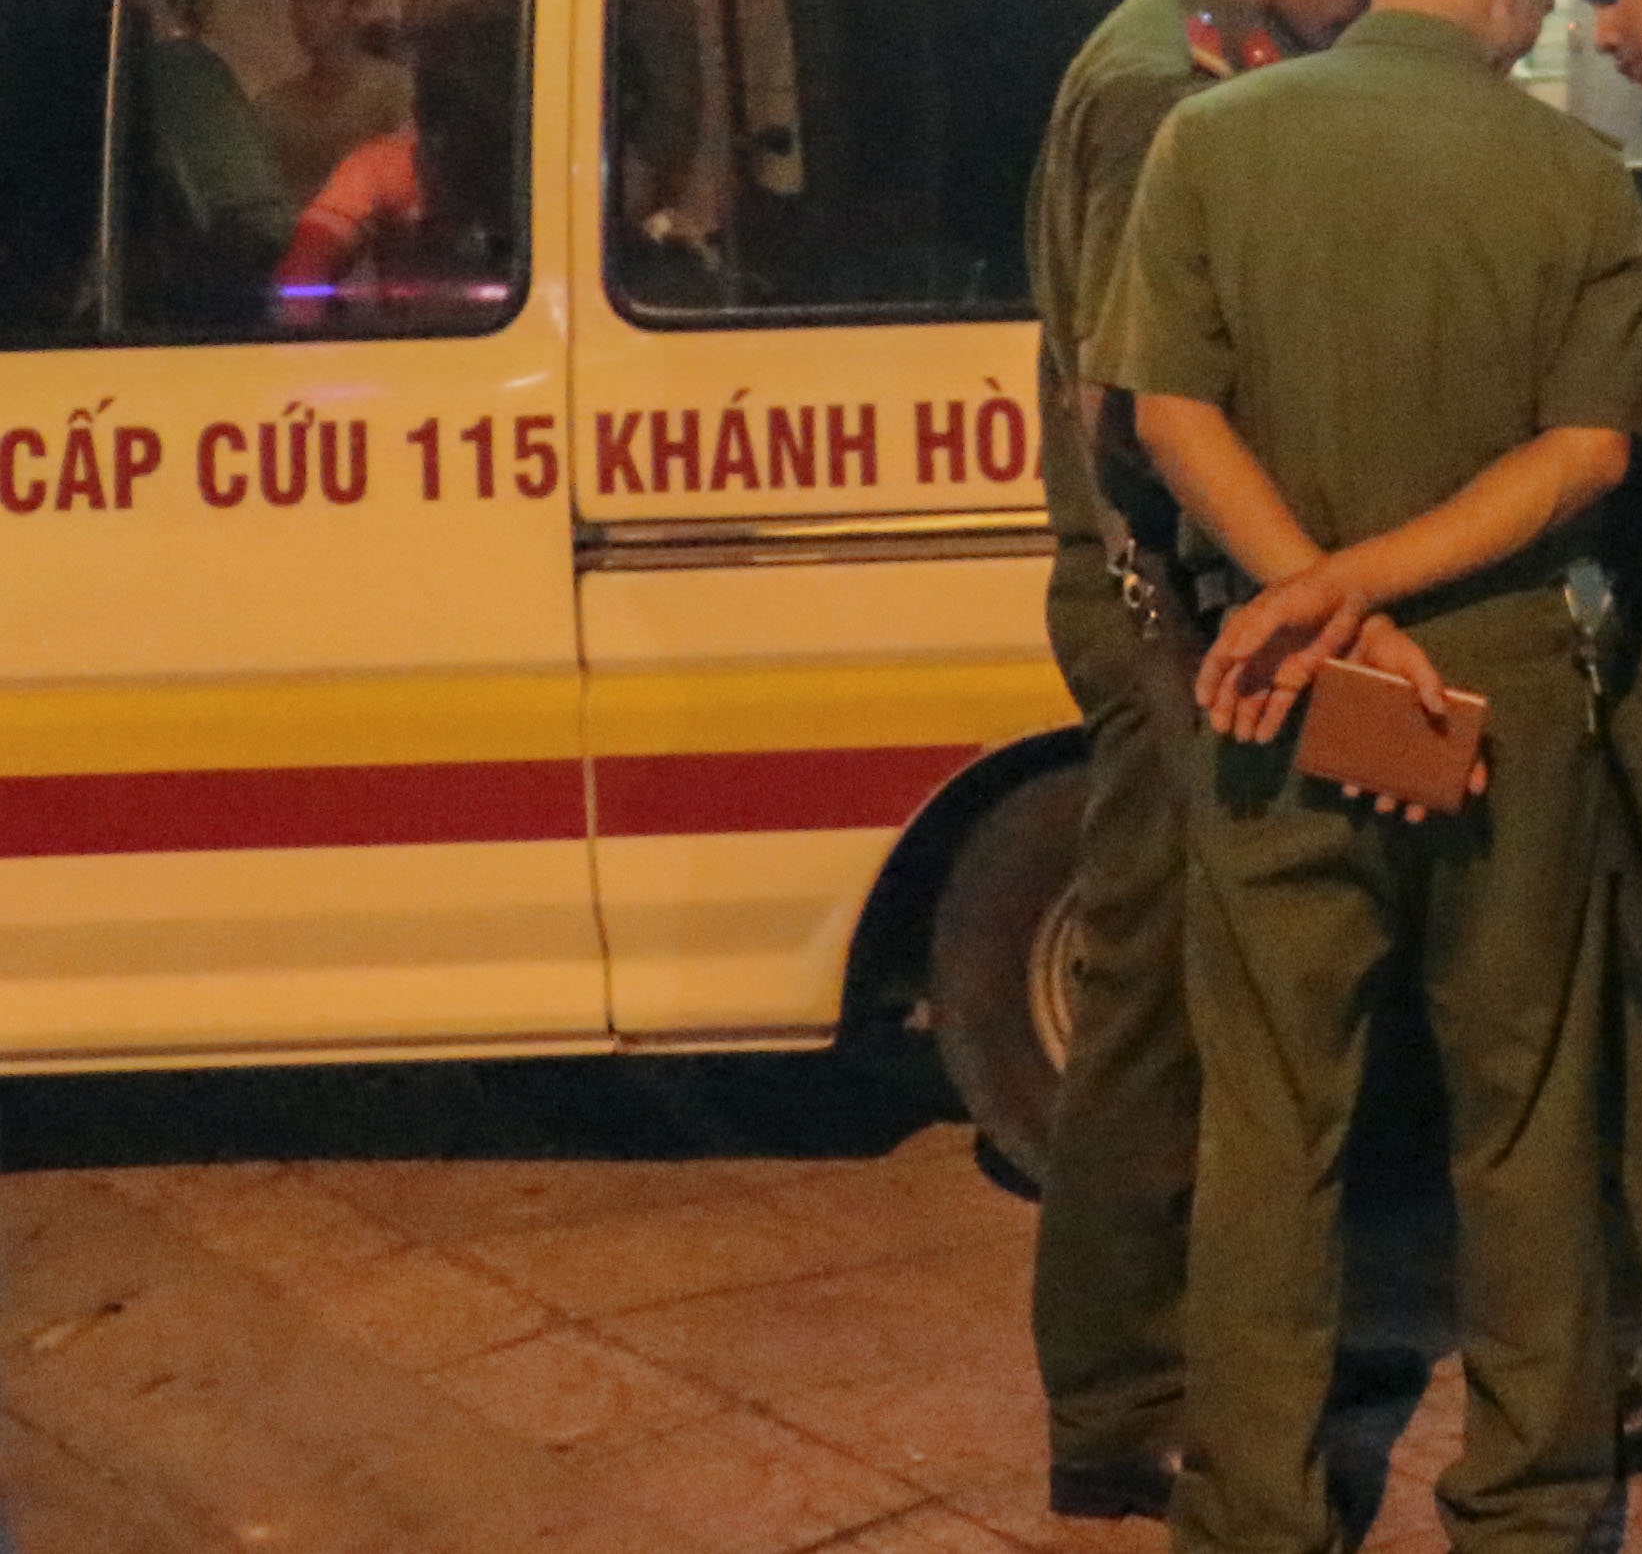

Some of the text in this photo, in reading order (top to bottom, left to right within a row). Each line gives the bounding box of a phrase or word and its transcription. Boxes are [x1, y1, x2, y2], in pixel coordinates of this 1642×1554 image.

[0, 398, 163, 513] CẤP
[197, 401, 368, 507] CỨU
[406, 414, 559, 502] 115
[596, 388, 878, 496] KHÁNH
